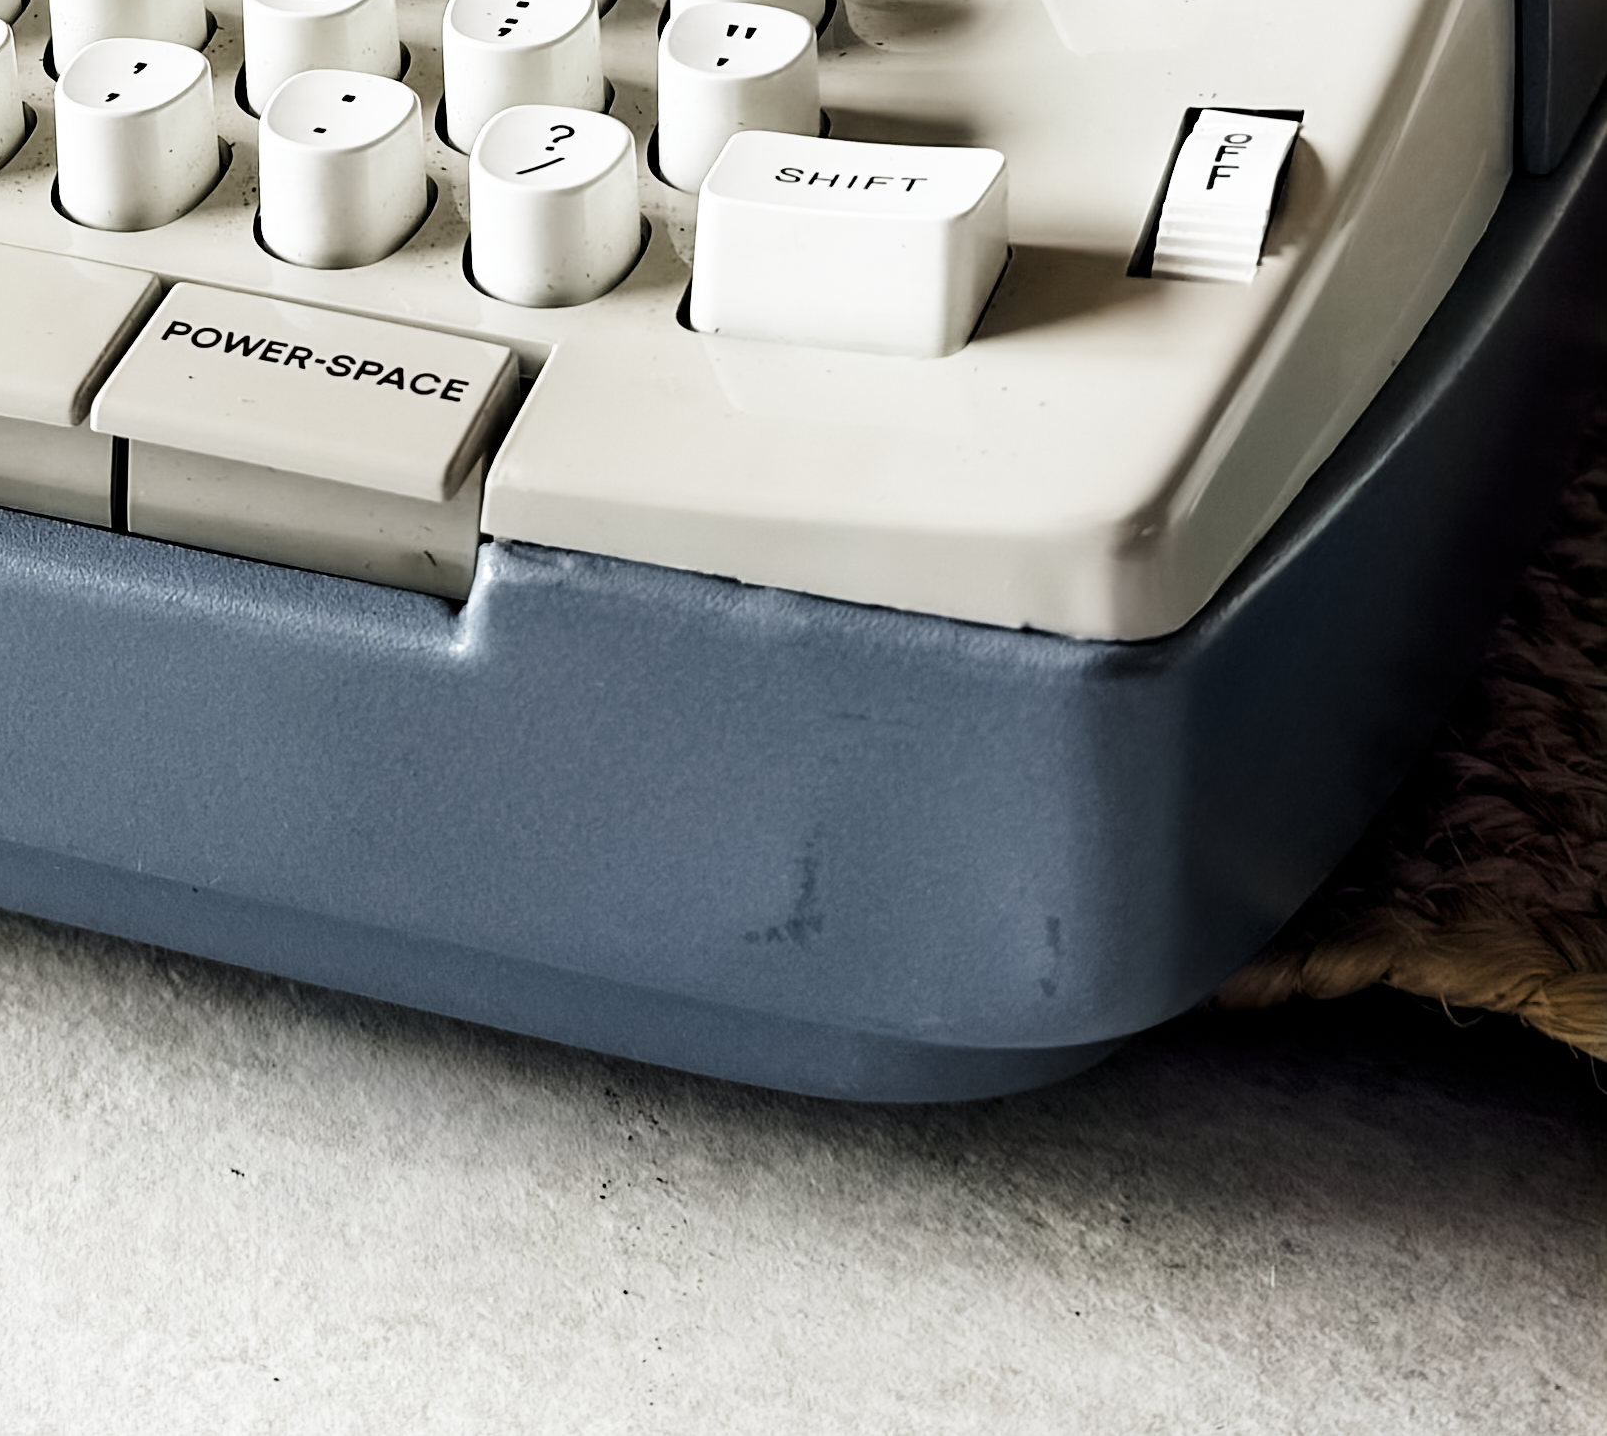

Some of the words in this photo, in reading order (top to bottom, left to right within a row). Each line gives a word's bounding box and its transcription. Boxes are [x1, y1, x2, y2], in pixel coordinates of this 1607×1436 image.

[545, 125, 575, 151] ?
[776, 168, 927, 191] SHIFT
[1206, 134, 1252, 190] OFF
[162, 321, 469, 402] POWER-SPACE
